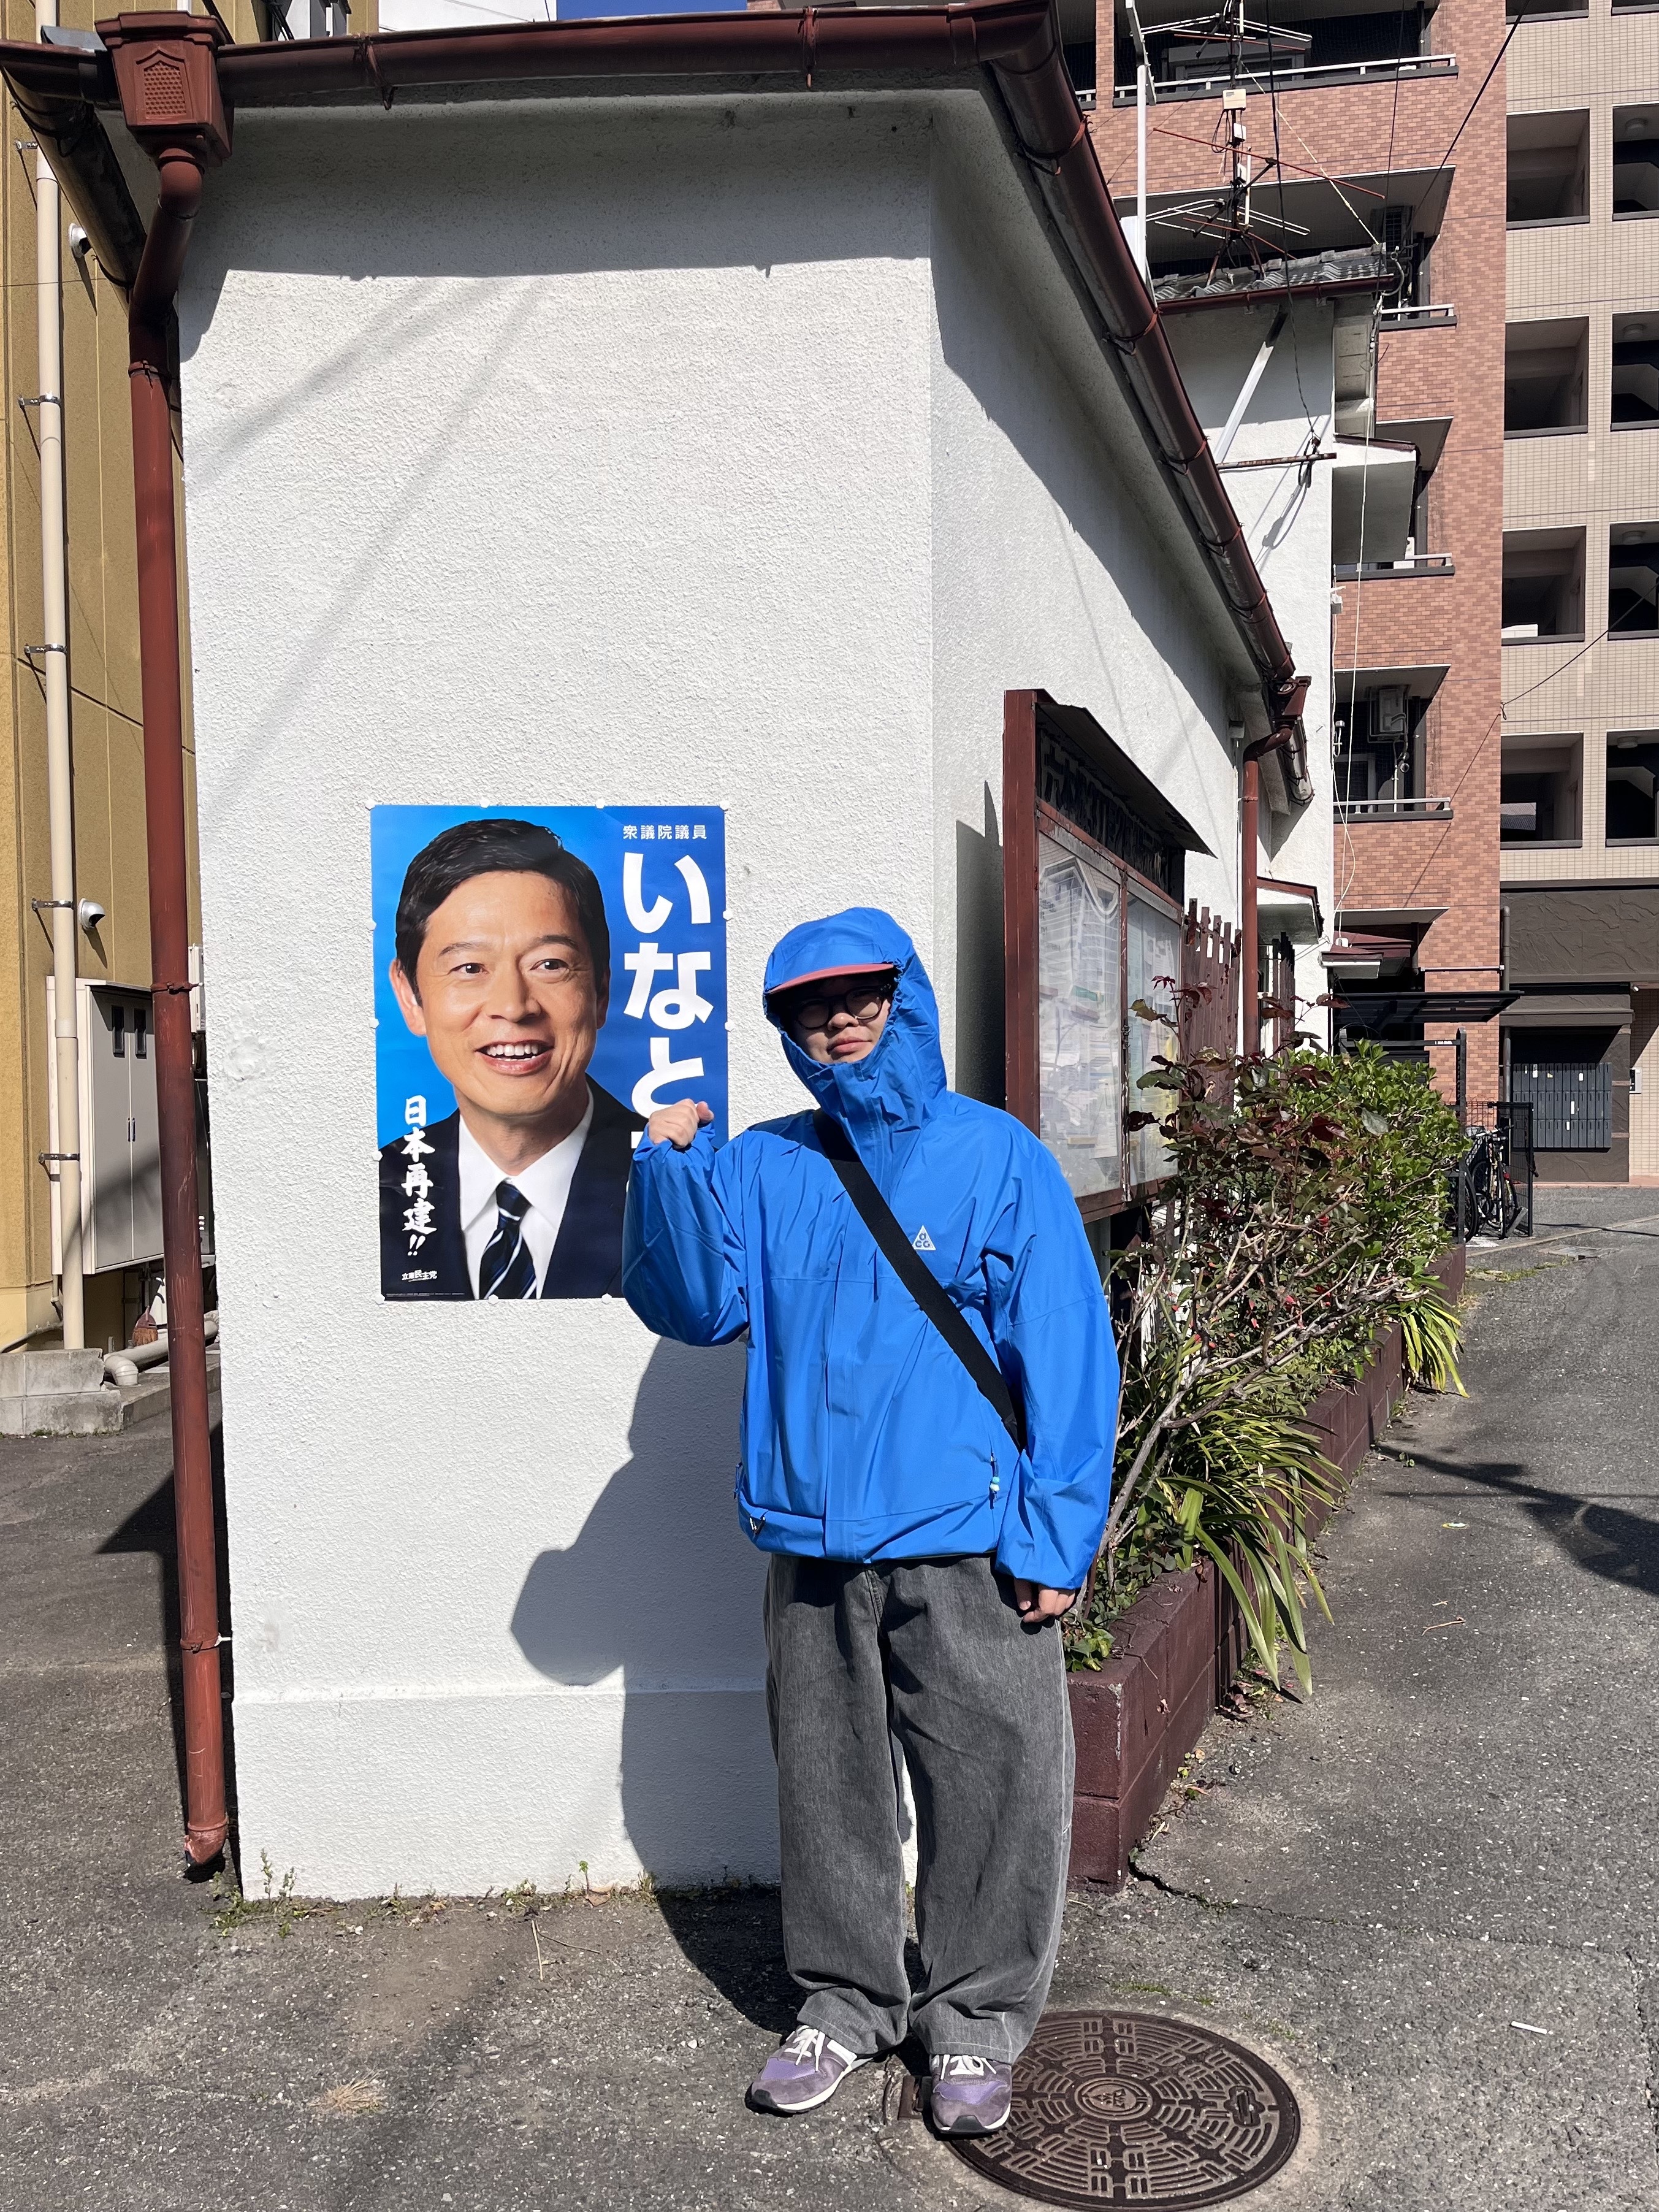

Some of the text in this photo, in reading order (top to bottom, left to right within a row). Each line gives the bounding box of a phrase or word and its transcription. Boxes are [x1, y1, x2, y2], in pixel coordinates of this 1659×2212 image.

[623, 825, 707, 840] 衆議院議員
[624, 852, 714, 1149] いなと
[400, 1095, 437, 1256] 日本再建!!
